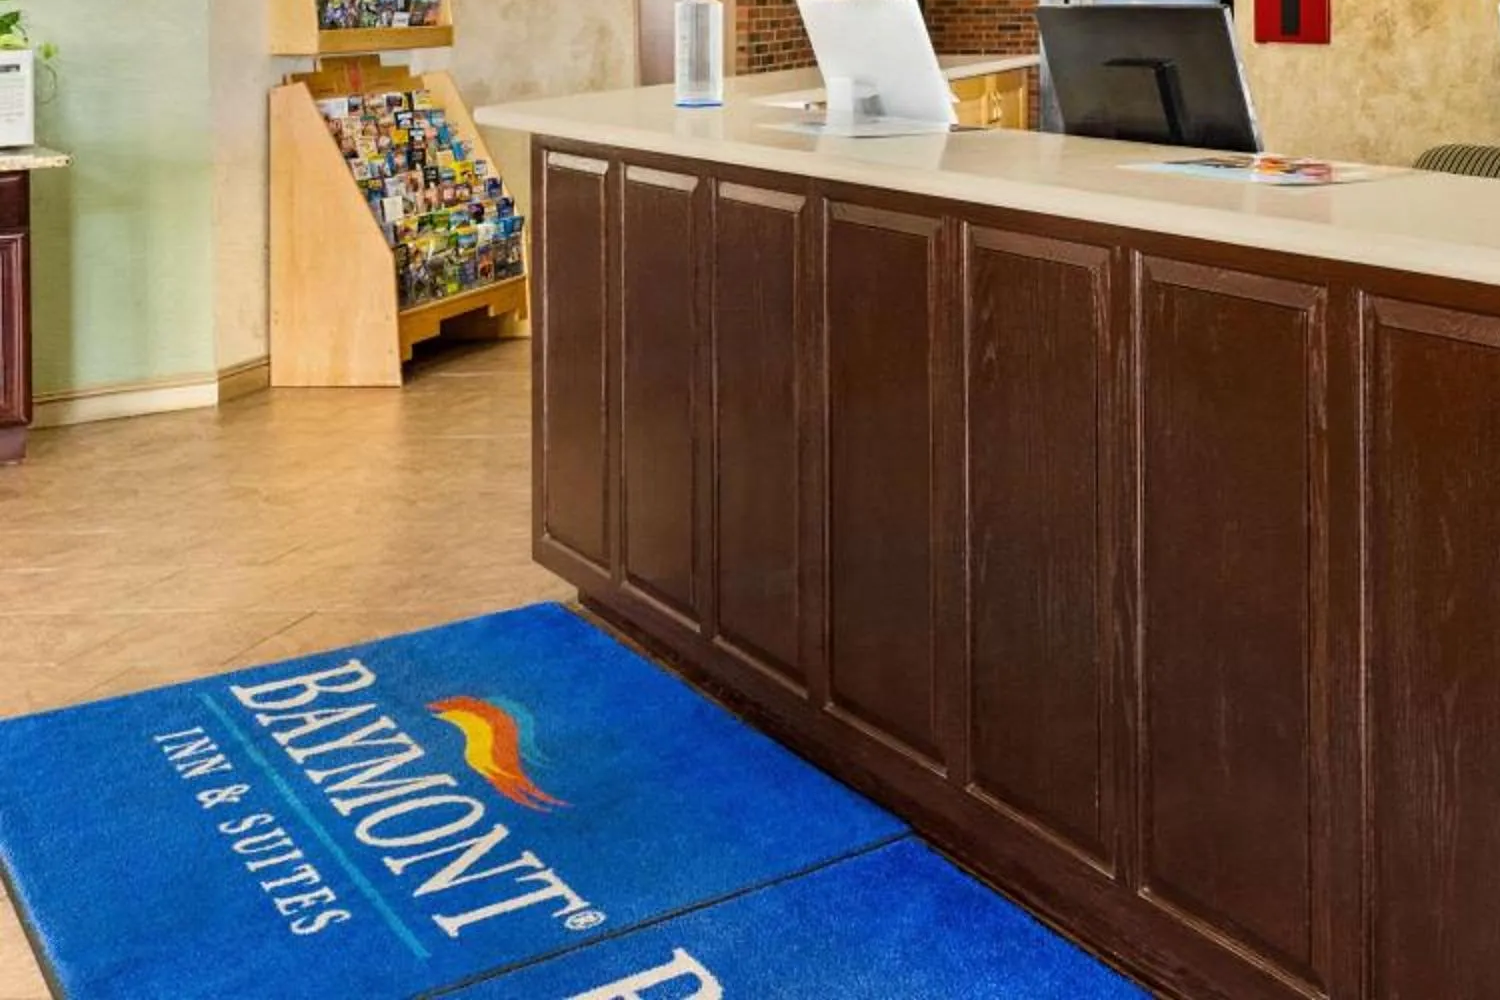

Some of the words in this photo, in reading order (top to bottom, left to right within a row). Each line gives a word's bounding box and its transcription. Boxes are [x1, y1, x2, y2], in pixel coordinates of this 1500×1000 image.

[154, 726, 232, 779] INN
[196, 783, 251, 809] &
[219, 813, 352, 935] SUITES
